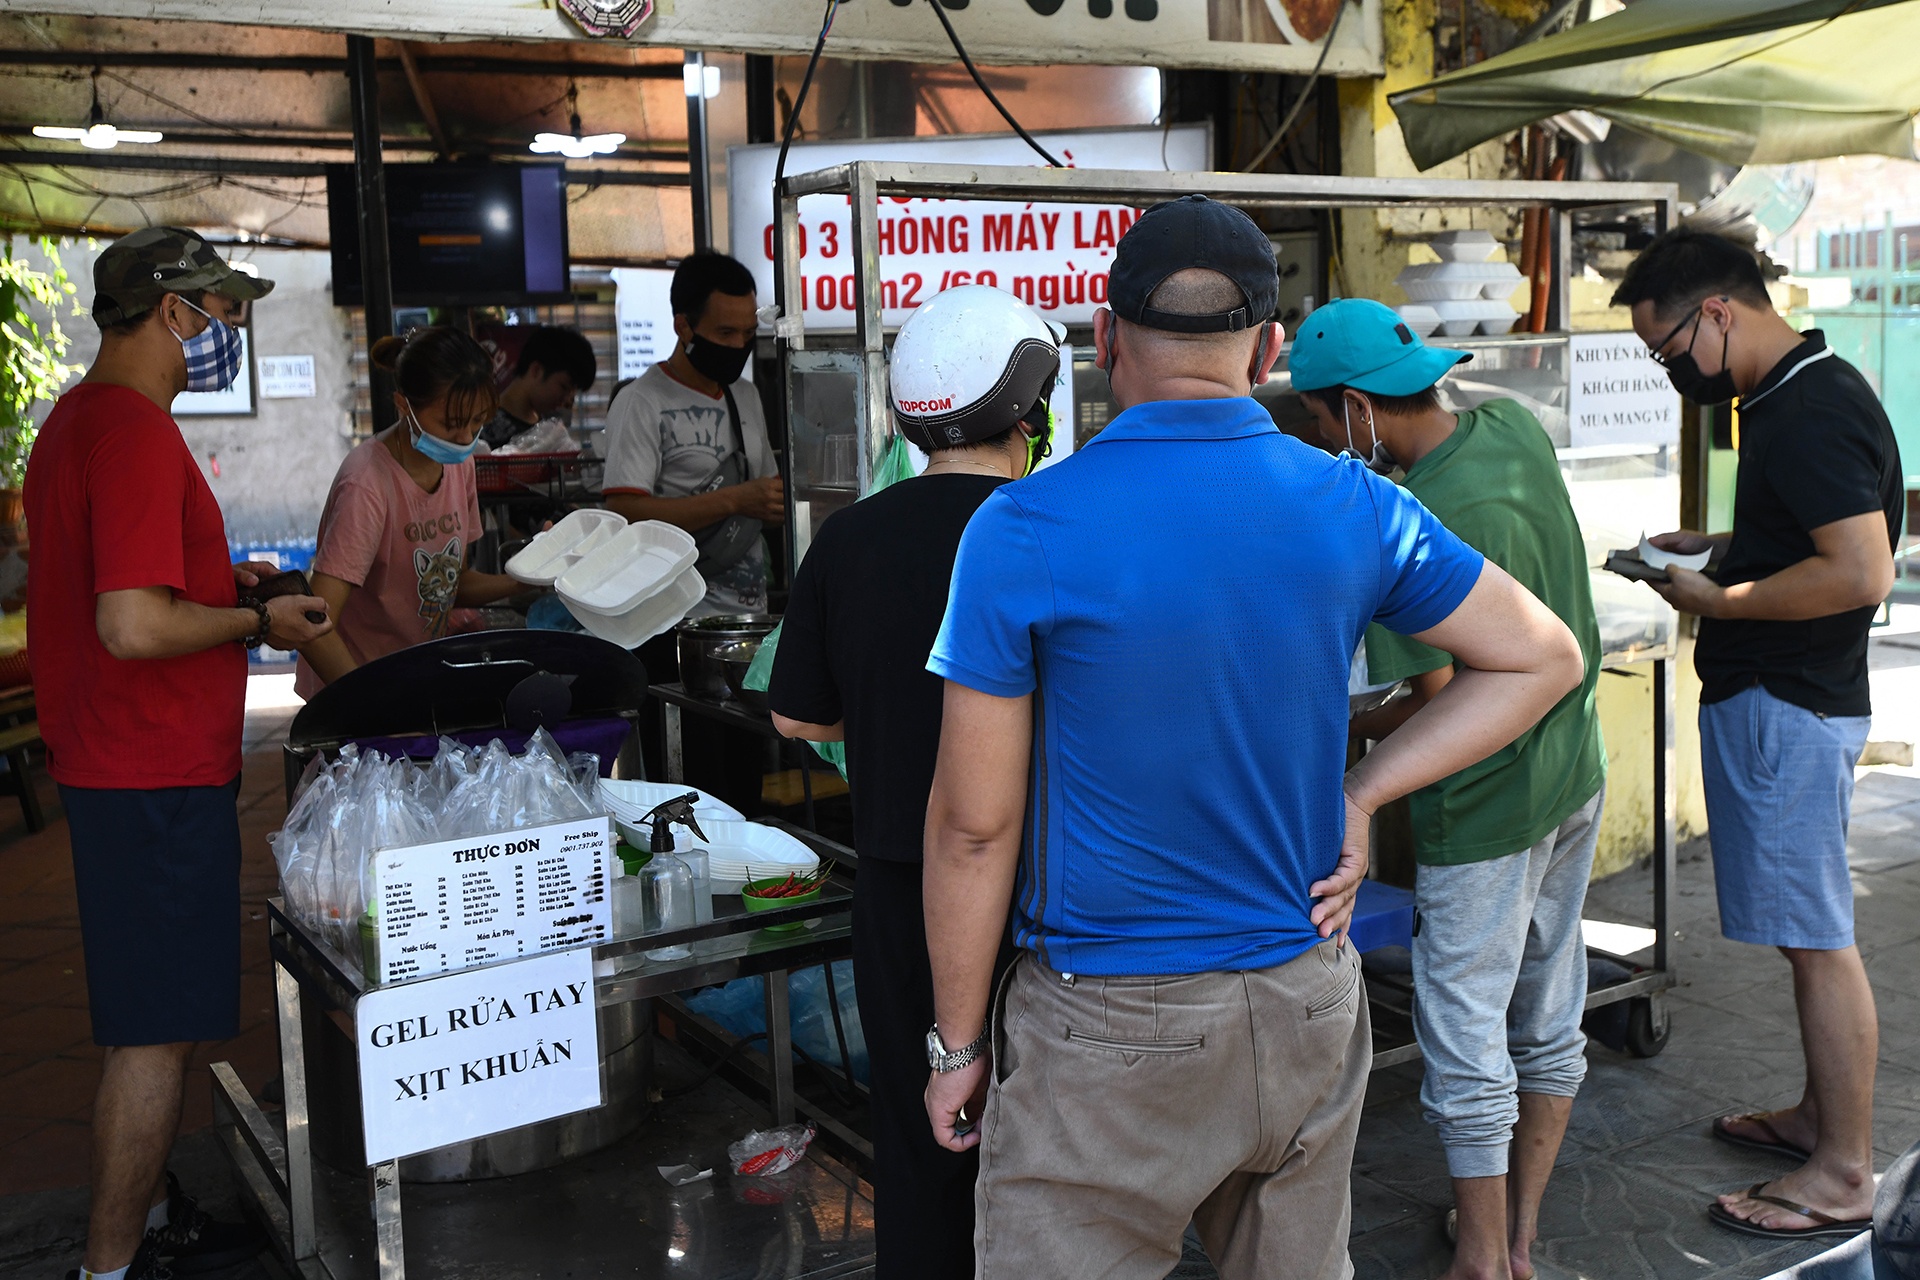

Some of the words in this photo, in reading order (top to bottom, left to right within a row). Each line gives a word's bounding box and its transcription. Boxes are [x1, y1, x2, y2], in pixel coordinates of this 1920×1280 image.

[819, 221, 839, 258] 3
[851, 208, 968, 256] HÒNG
[983, 201, 1060, 253] MÁY
[1074, 208, 1144, 256] LẠN
[1582, 376, 1629, 395] KHÁCH
[898, 397, 952, 413] TOPCOM
[1580, 413, 1609, 428] MUA
[582, 831, 598, 839] Ship
[453, 844, 500, 863] THỰC
[505, 838, 540, 856] ĐƠN
[371, 1015, 438, 1048] GEL
[447, 996, 517, 1033] RỬA
[524, 981, 587, 1014] TAY
[394, 1067, 450, 1101] XỊT
